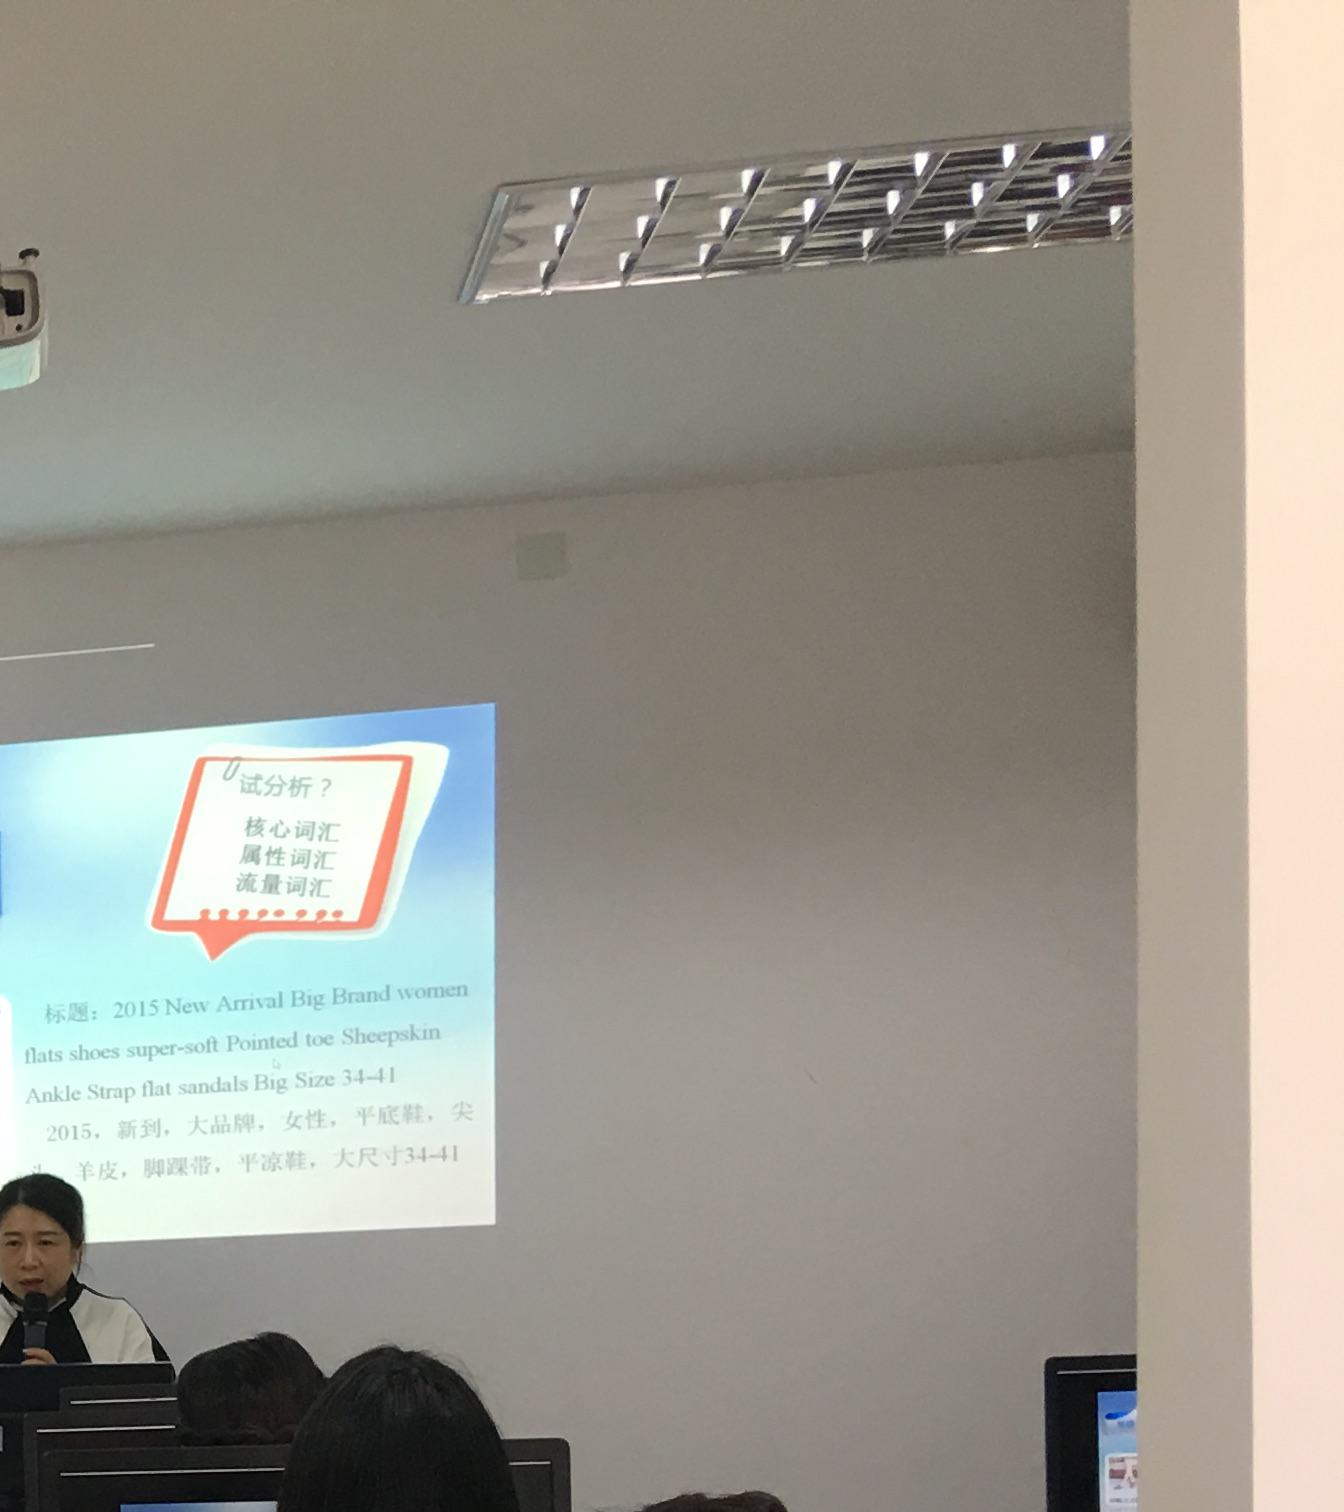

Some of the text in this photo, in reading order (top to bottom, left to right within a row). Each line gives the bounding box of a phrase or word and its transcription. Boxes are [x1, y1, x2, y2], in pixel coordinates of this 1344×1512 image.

[244, 816, 341, 842] 核心词汇
[239, 844, 337, 869] 属性词汇
[236, 872, 333, 898] 流量词汇
[165, 998, 208, 1015] New
[216, 992, 283, 1013] Arrival
[290, 989, 324, 1011] Big
[332, 985, 391, 1005] Brand
[398, 981, 468, 1001] women
[25, 1024, 441, 1065] flats shoes super-soft Pointed toe Sheepskin
[26, 1067, 397, 1105] Ankle Strap flat sandals Big Size 34-41
